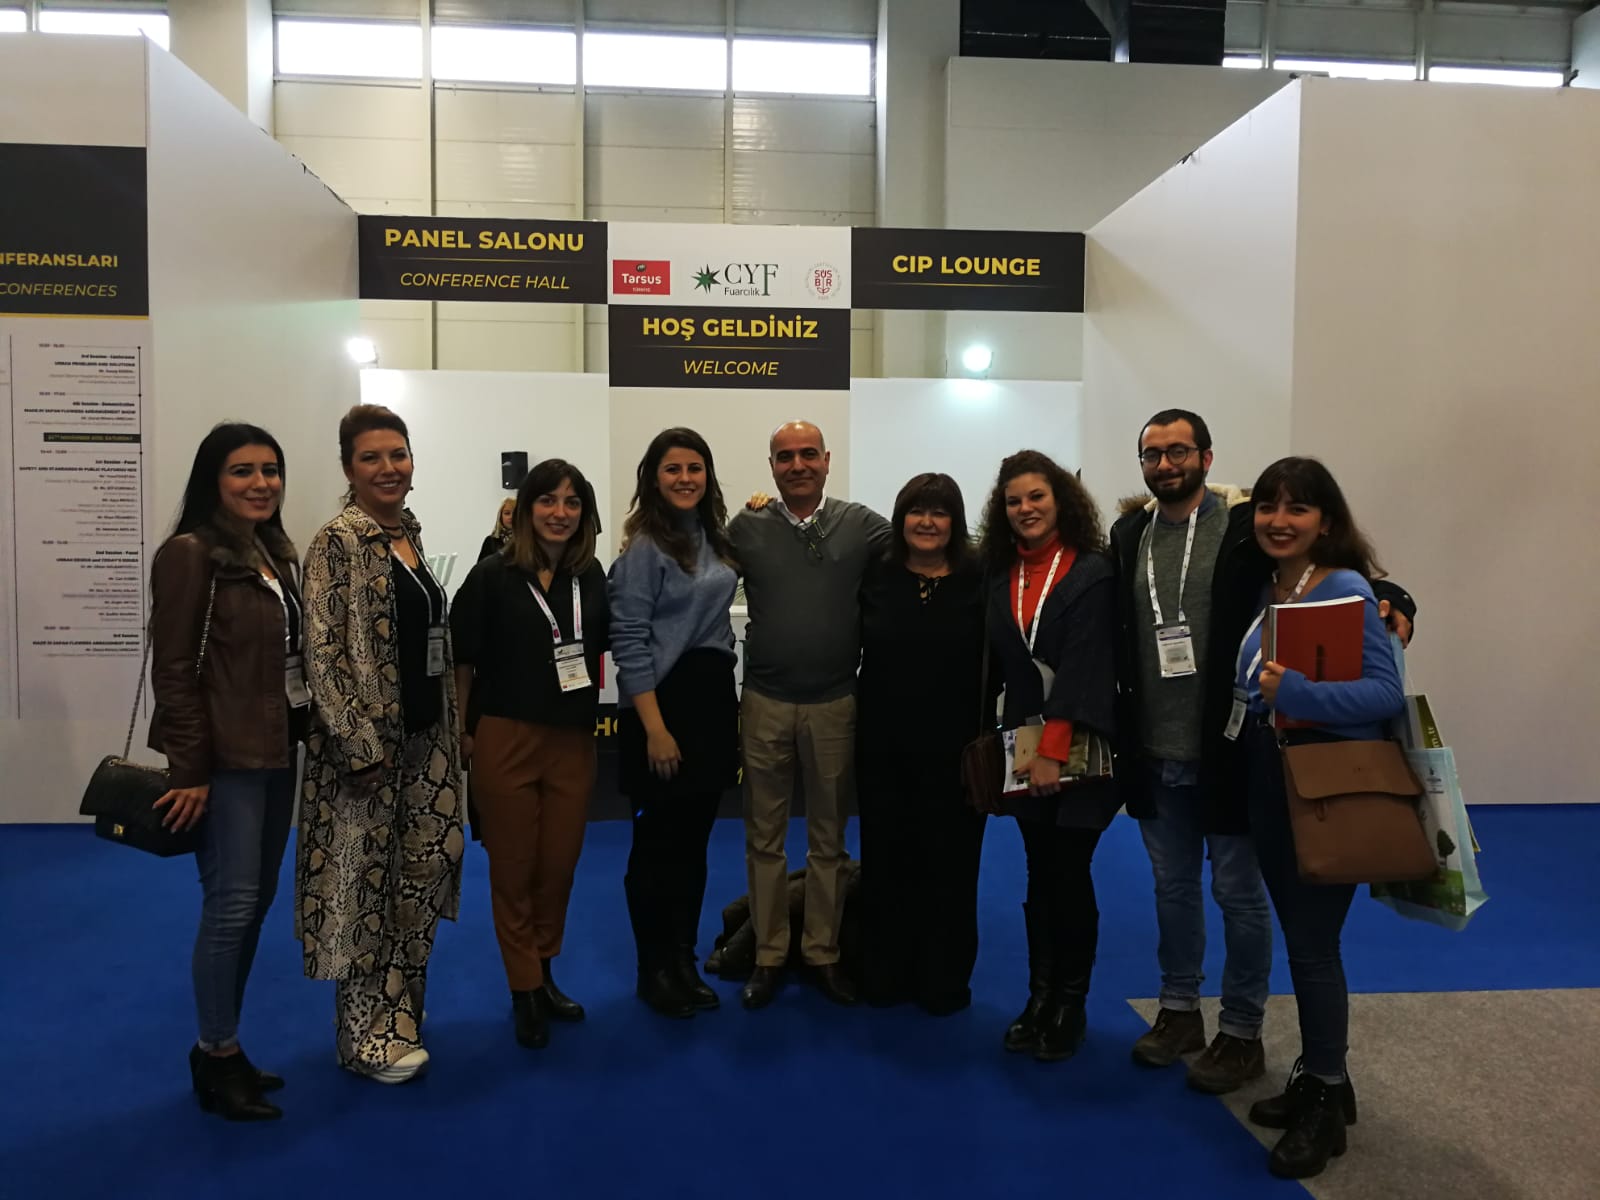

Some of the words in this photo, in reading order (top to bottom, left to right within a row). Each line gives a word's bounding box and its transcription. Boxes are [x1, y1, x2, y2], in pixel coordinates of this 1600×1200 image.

[384, 228, 472, 249] PANEL
[478, 231, 585, 252] SALONU
[892, 255, 933, 273] CIP
[940, 256, 1041, 276] LOUNGE
[400, 272, 521, 289] CONFERENCE
[525, 275, 570, 290] HALL
[621, 272, 663, 285] Tarsus
[724, 262, 779, 297] CYF
[642, 317, 696, 342] HOŞ
[683, 360, 780, 376] WELCOME
